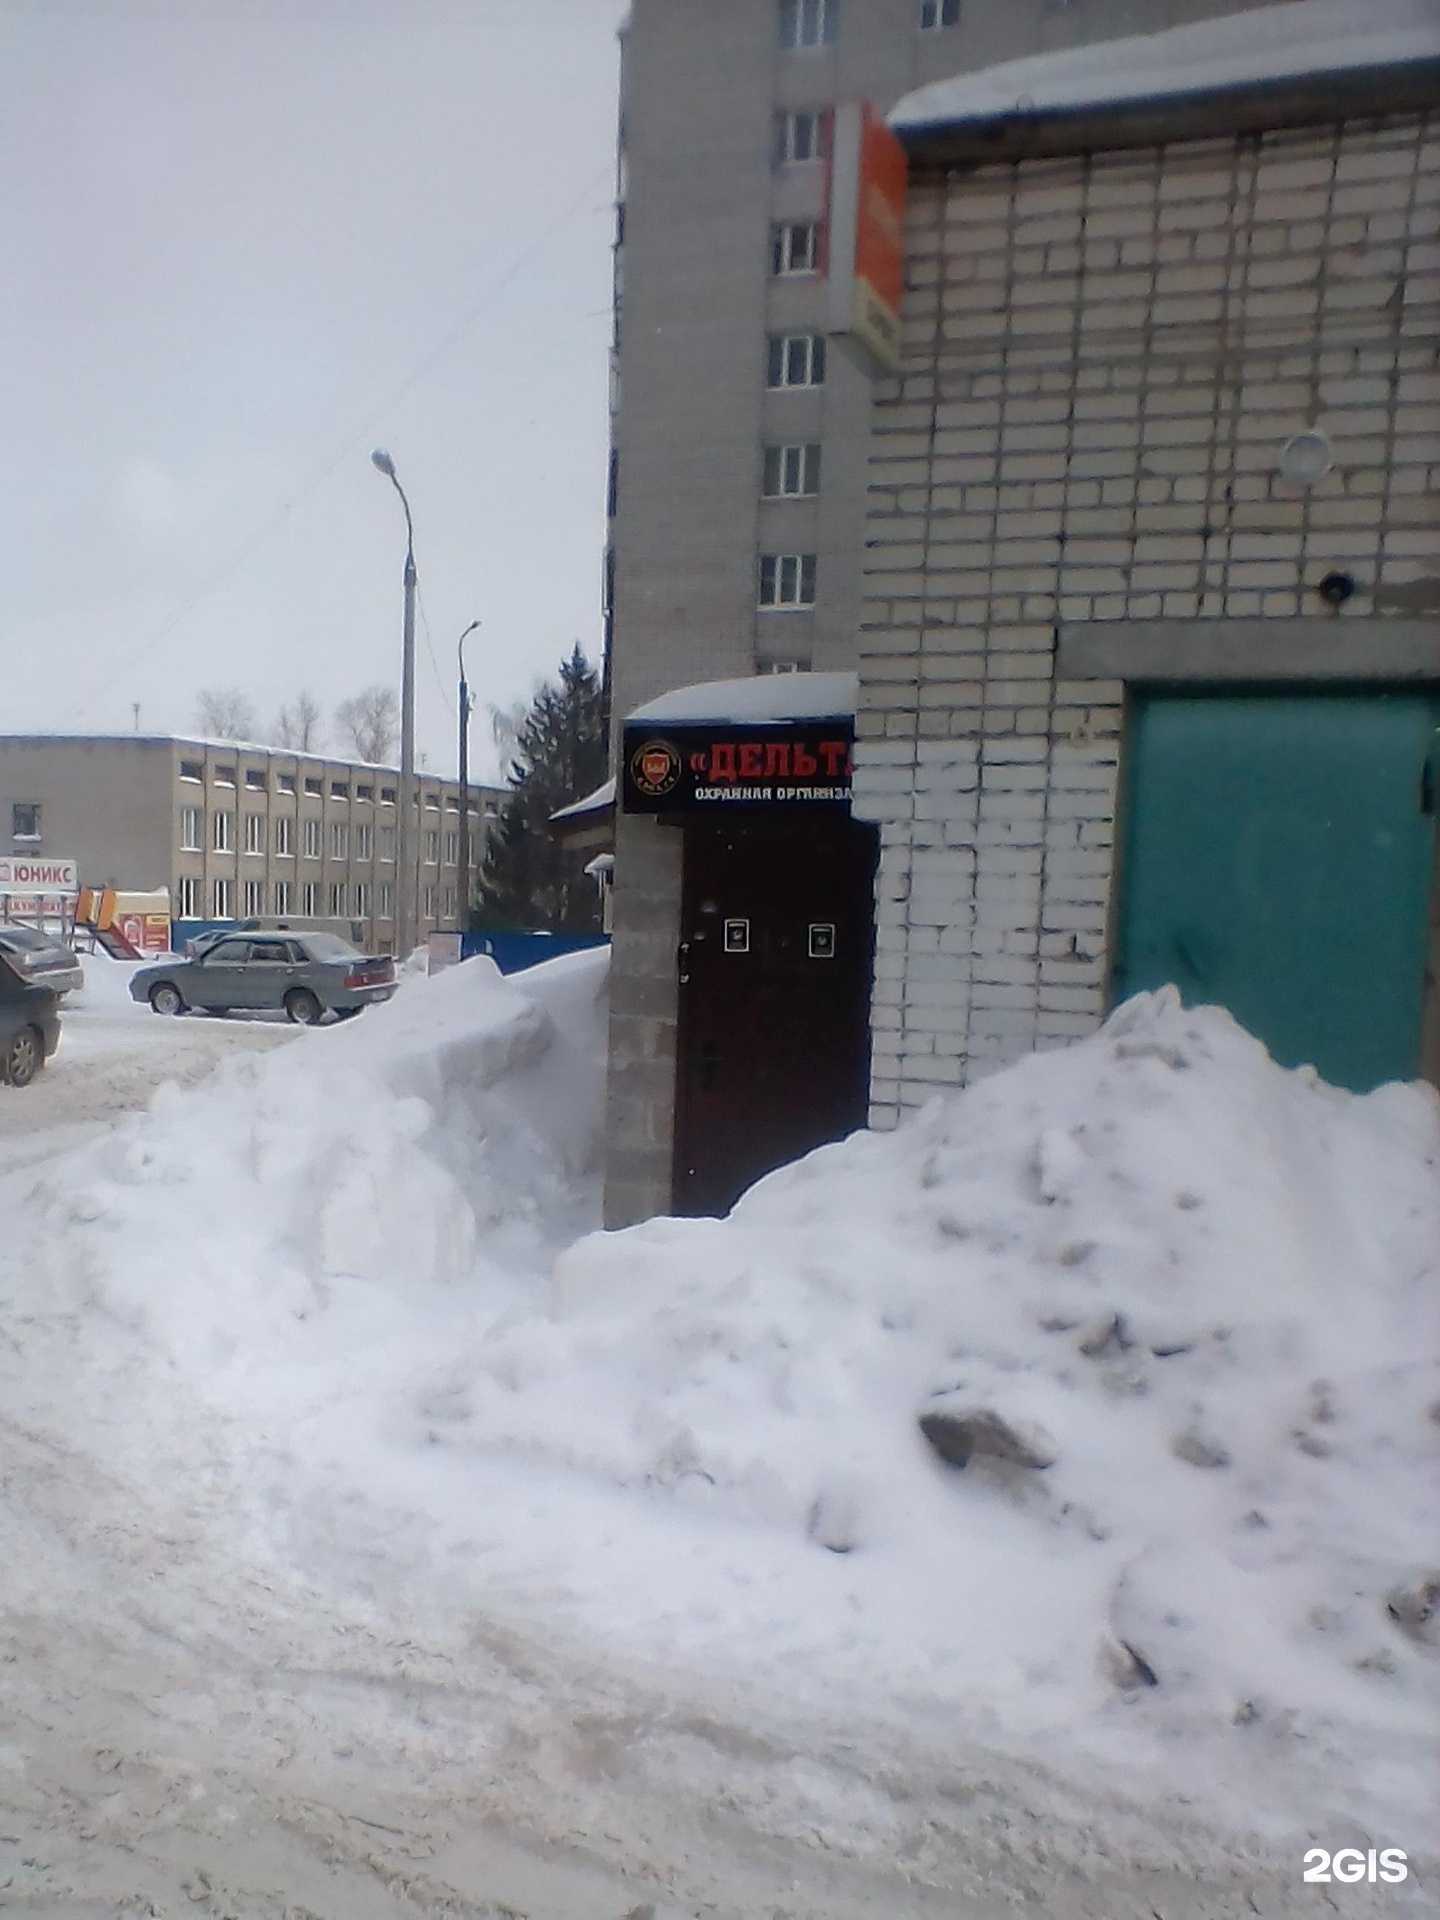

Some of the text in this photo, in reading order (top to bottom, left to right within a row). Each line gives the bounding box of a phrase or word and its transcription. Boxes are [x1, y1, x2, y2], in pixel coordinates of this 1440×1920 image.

[690, 741, 854, 782] «ДЕЛЬТ
[695, 787, 771, 801] ОХРАННАЯ
[14, 865, 72, 883] ЮНИКС
